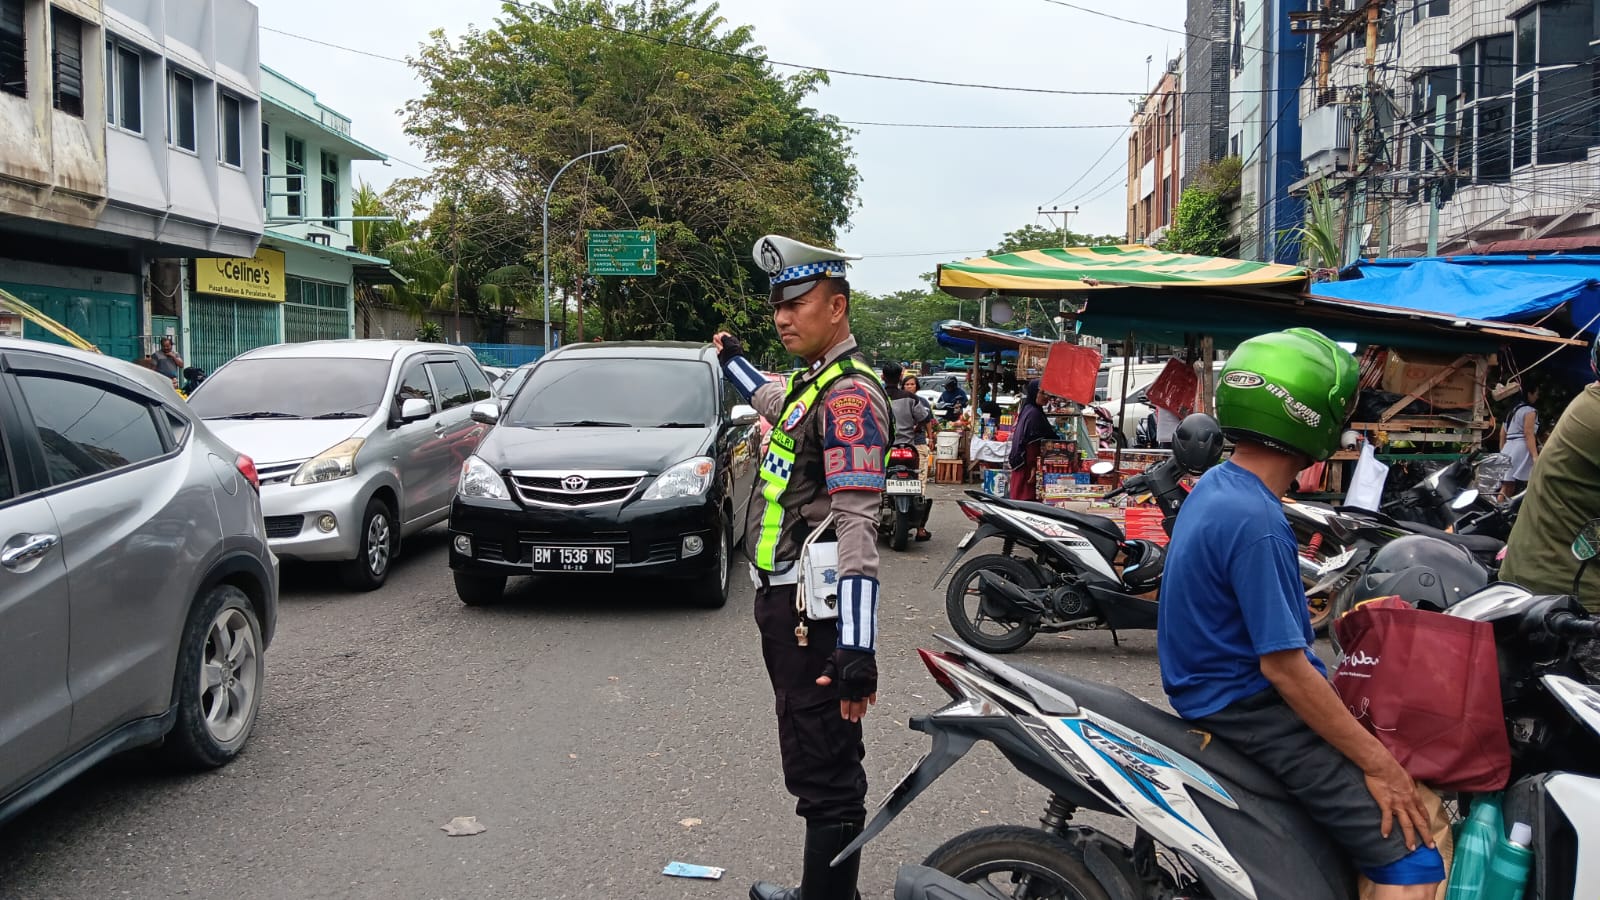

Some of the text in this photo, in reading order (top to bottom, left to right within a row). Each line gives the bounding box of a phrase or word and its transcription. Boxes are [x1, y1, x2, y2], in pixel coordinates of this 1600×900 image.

[224, 261, 270, 285] Celine's
[774, 430, 793, 449] POLRI
[534, 548, 612, 564] BM 1536 NS
